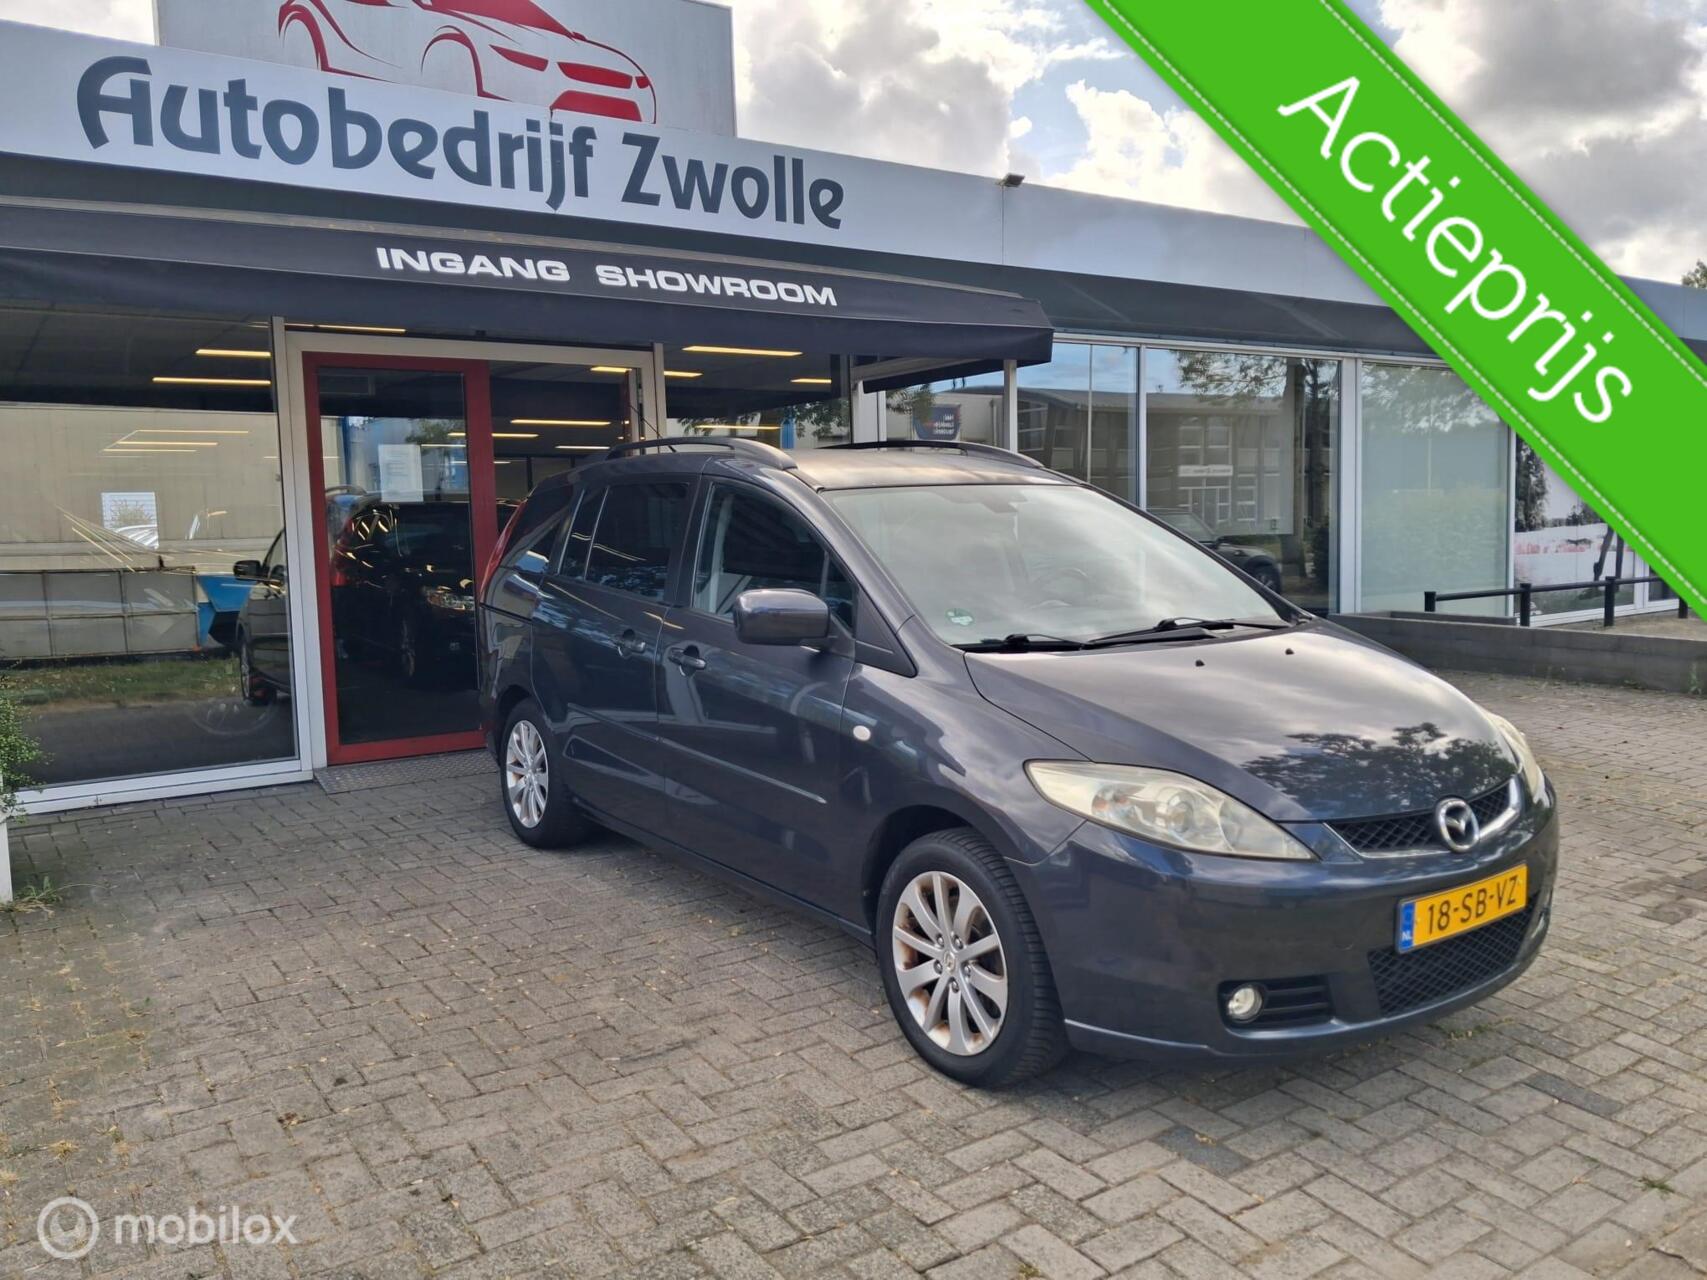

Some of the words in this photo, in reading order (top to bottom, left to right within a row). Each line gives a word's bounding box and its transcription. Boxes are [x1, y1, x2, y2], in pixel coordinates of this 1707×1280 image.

[77, 56, 597, 211] Autobedrijf
[621, 132, 844, 231] Zwolle
[376, 247, 570, 281] INGANG
[595, 264, 838, 306] SHOWROOM
[1427, 875, 1518, 935] 18-SB-VZ
